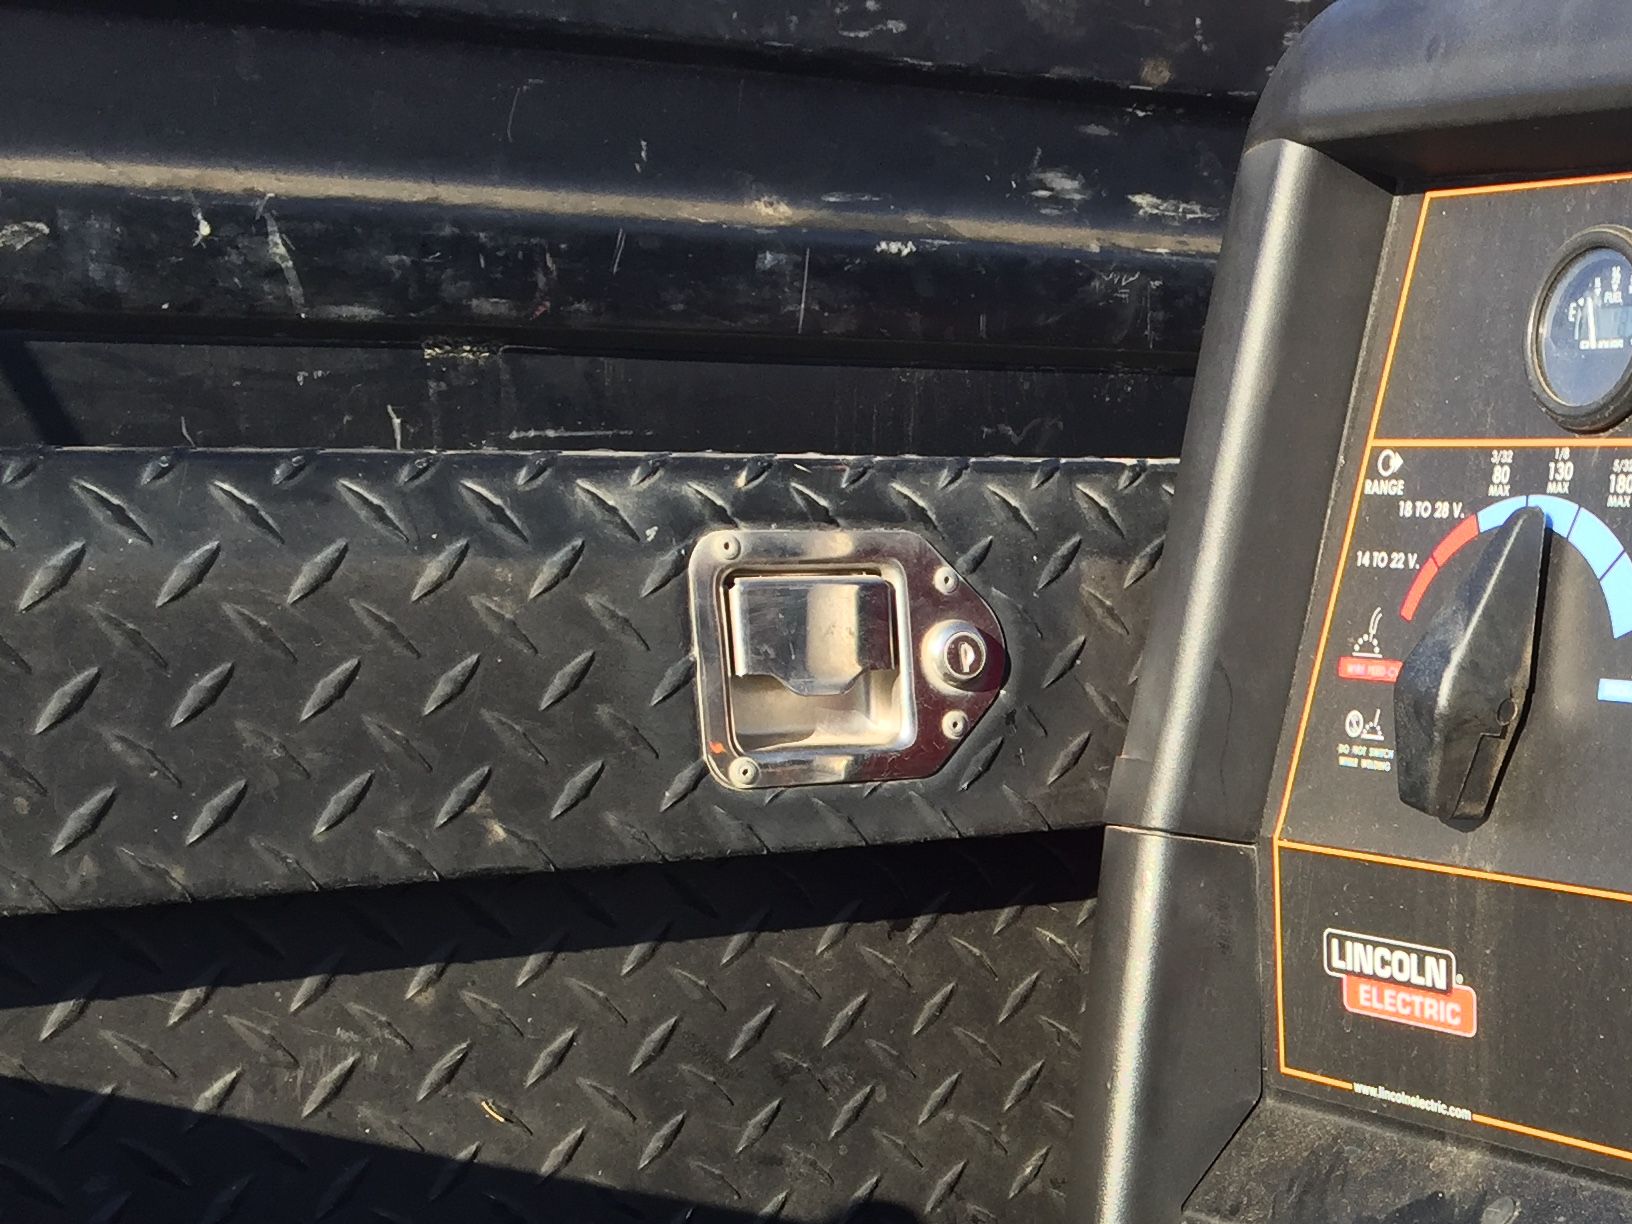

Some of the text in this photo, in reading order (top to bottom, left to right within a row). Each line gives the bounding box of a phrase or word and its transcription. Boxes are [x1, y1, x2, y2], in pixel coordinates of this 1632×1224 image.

[1491, 449, 1514, 464] 3/32
[1555, 447, 1571, 460] 1/8
[1492, 464, 1511, 484] 80
[1549, 460, 1574, 481] 130
[1364, 479, 1405, 495] RANGE
[1488, 484, 1511, 497] MAX
[1546, 481, 1570, 494] MAX
[1399, 500, 1465, 518] 18 TO 28 V.
[1606, 495, 1632, 508] MAX
[1357, 551, 1420, 570] 14 TO 22 V.
[1331, 937, 1447, 991] LINCOLN
[1358, 983, 1462, 1026] ELECTRIC
